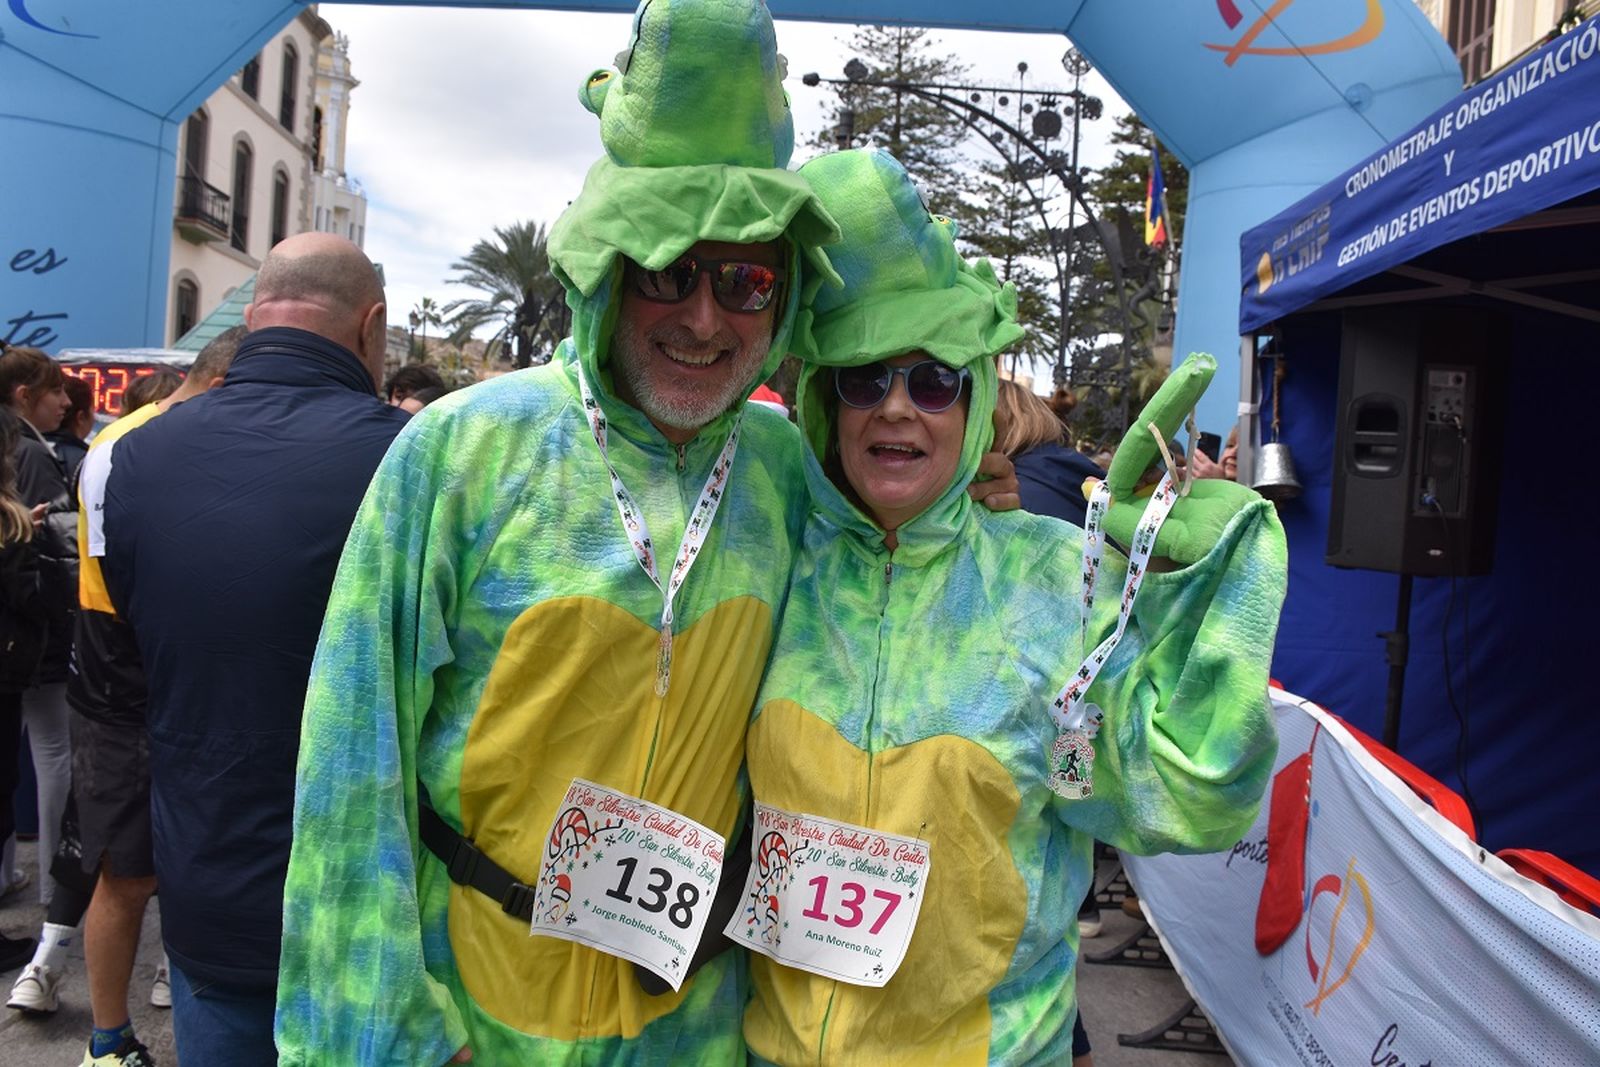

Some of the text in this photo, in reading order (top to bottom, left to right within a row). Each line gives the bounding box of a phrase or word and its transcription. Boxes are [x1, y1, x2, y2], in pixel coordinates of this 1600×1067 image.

[1345, 19, 1600, 198] CRONOMETRAJE ORGANIZACIÓ
[1444, 150, 1455, 176] Y
[1337, 224, 1389, 267] GESTIÓN
[1389, 212, 1408, 243] DE
[1409, 177, 1480, 233] EVENTOS
[10, 247, 68, 275] es
[576, 788, 597, 807] San
[643, 811, 688, 839] Ciudad
[682, 828, 701, 849] De
[638, 834, 659, 852] San
[828, 827, 870, 851] Ciudad
[868, 836, 891, 857] De
[893, 843, 926, 865] Ceuta
[826, 851, 847, 867] San
[848, 856, 889, 877] Silvestre
[891, 866, 920, 888] Baby
[605, 856, 700, 930] 138
[802, 875, 902, 935] 137
[591, 905, 688, 956] Jorge Robledo Santiago
[805, 930, 824, 941] Ana
[825, 935, 862, 952] Moreno
